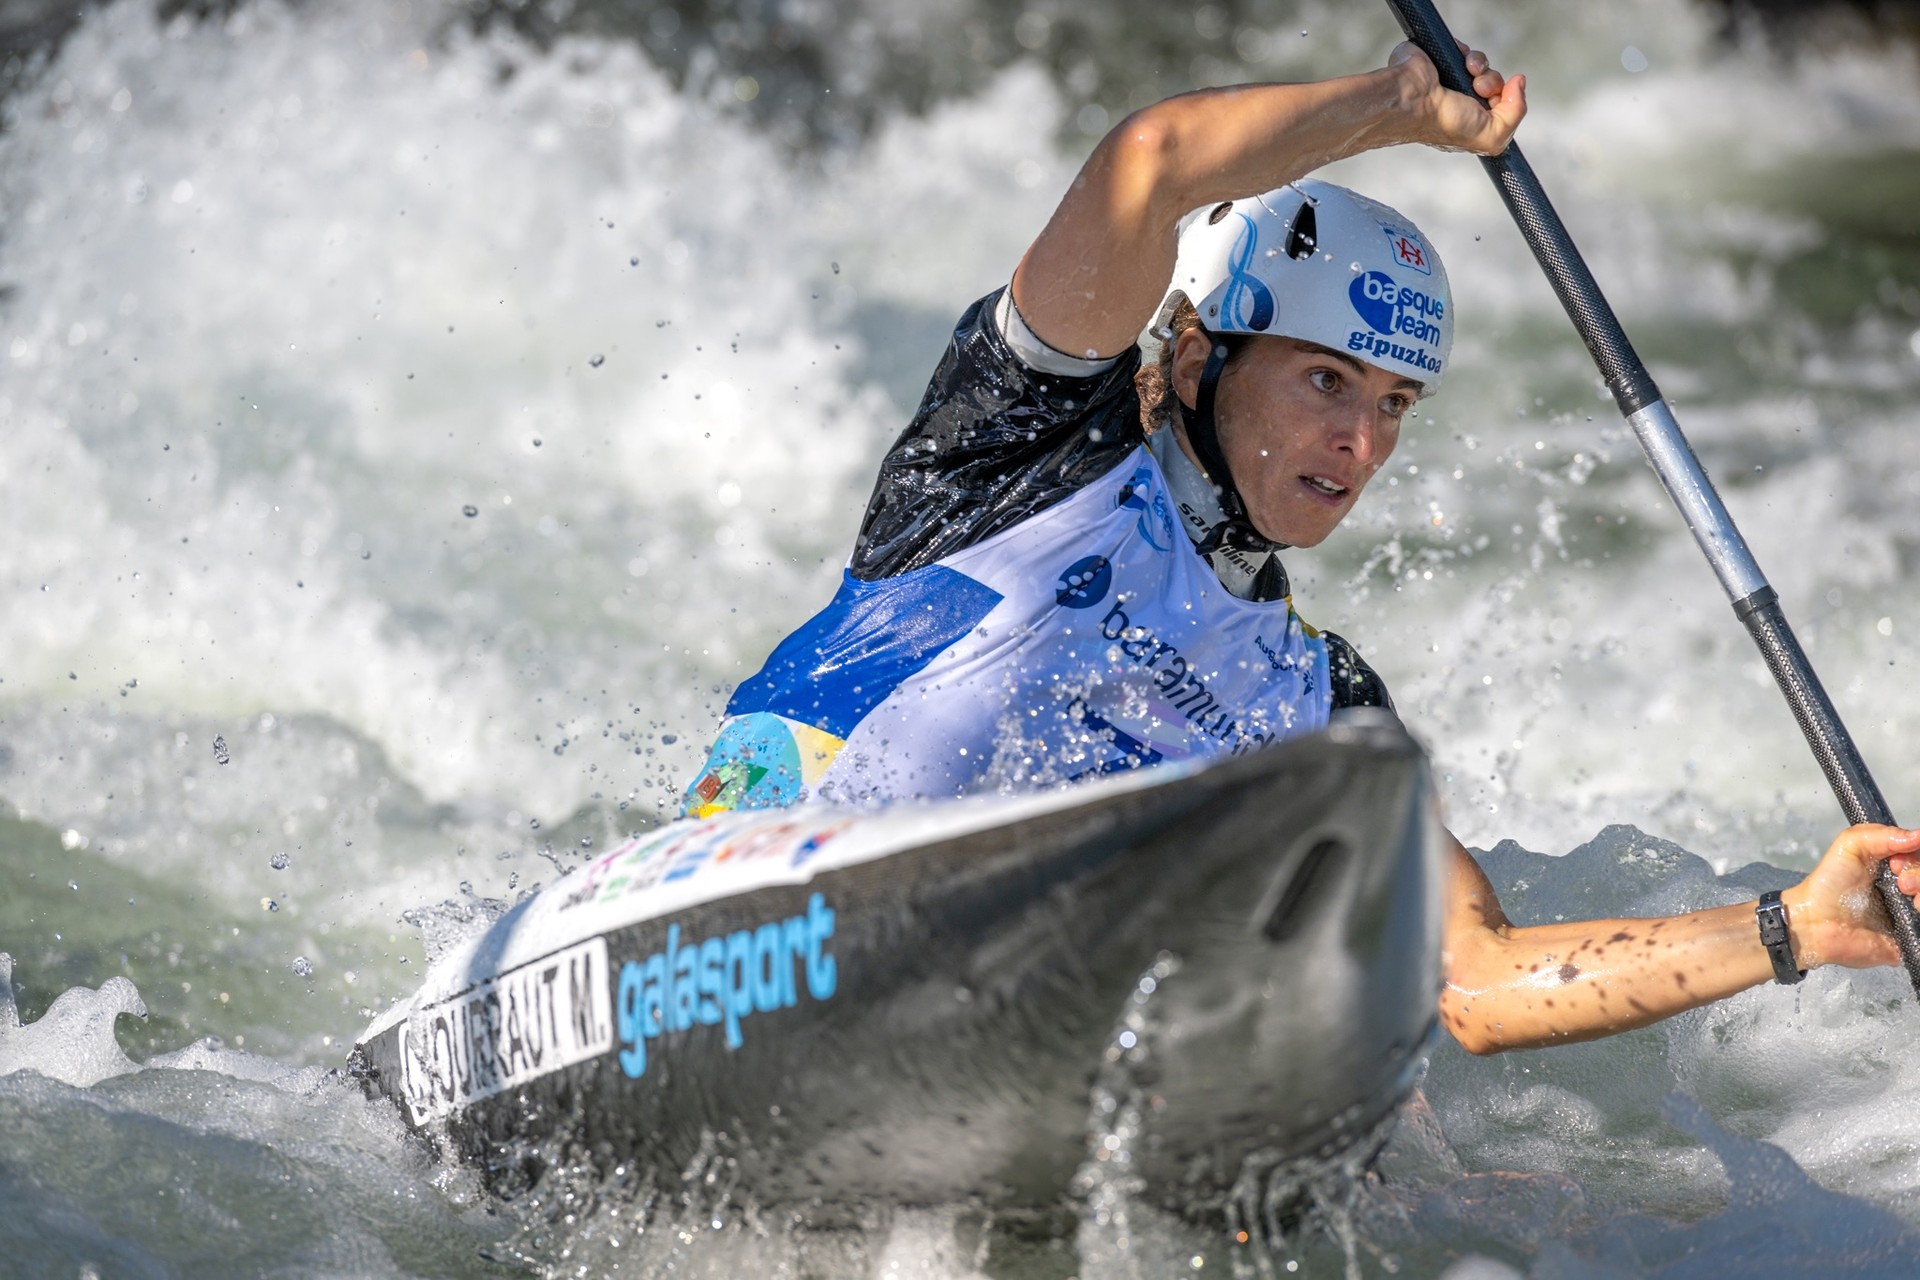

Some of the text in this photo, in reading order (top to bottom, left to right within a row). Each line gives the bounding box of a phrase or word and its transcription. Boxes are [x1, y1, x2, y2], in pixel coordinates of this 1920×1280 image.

[1363, 272, 1444, 320] basque
[1389, 304, 1441, 348] team
[1347, 331, 1442, 374] gipuzkoa
[618, 891, 837, 1079] galasport
